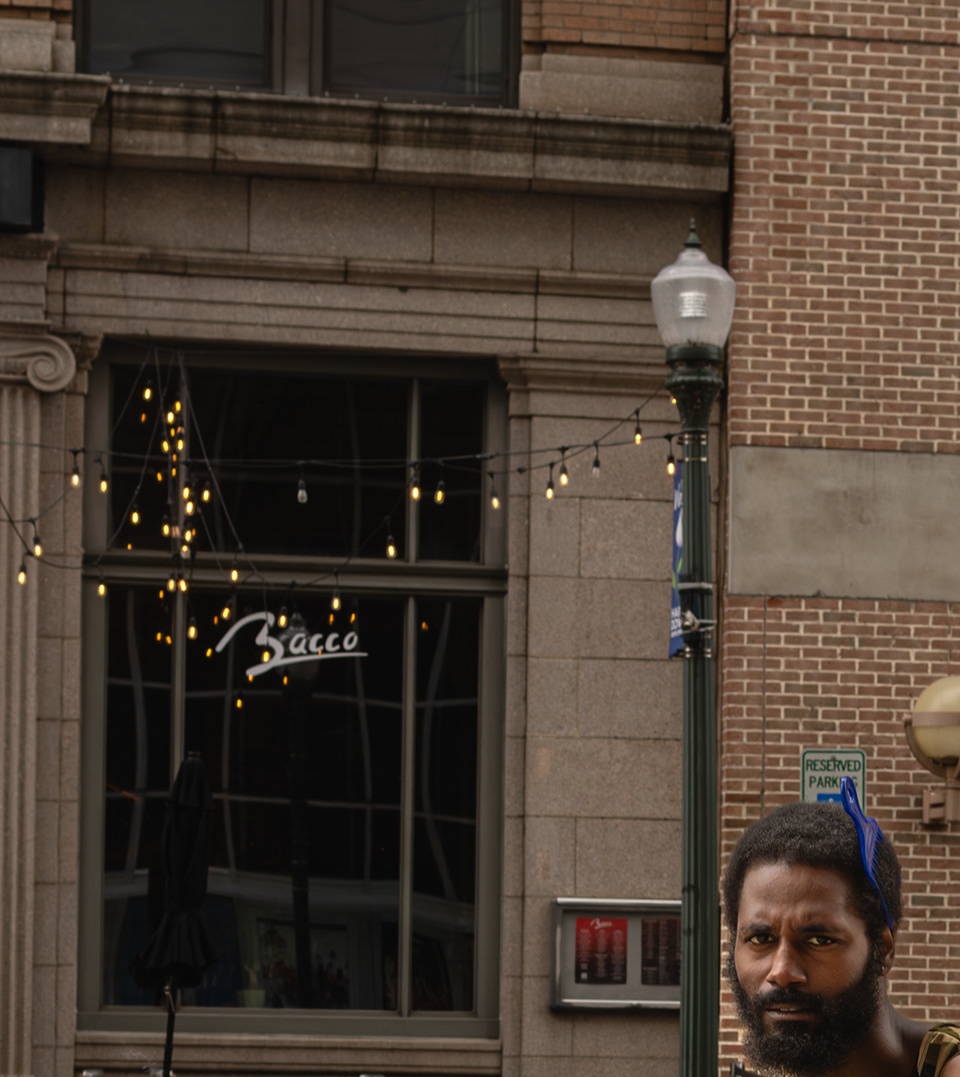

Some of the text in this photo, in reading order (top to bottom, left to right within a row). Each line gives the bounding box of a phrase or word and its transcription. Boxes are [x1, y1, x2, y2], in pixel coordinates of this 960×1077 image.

[214, 611, 369, 677] Bacco
[805, 759, 861, 772] RESERVED
[809, 776, 859, 788] PARKIG
